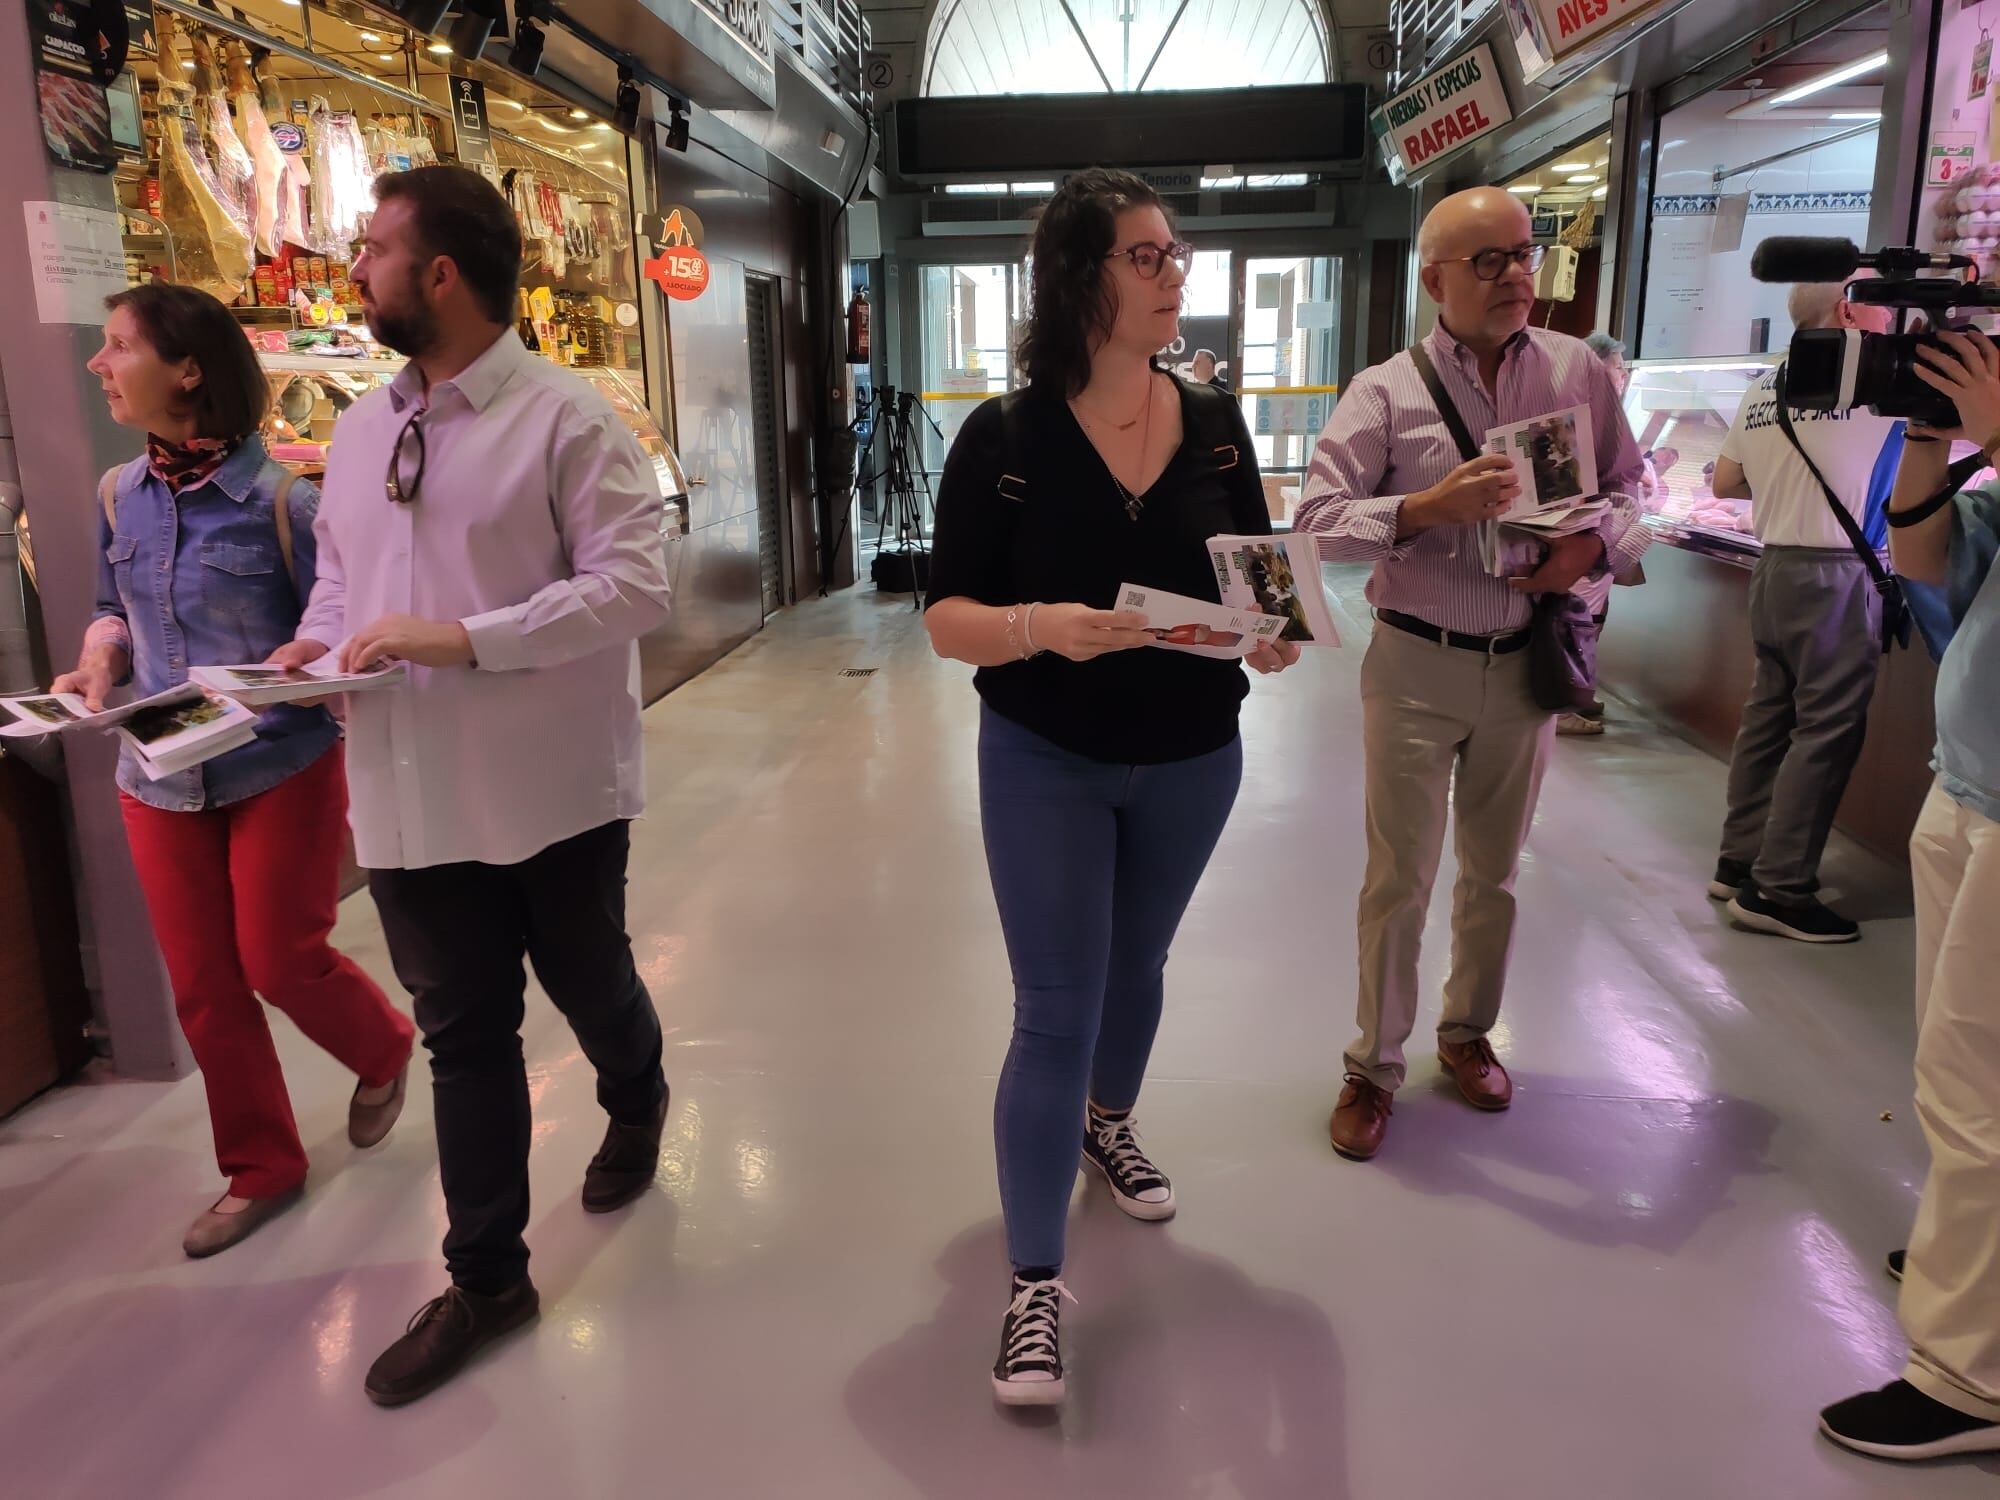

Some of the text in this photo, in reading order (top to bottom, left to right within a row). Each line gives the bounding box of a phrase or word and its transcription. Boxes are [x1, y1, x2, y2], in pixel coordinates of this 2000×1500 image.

[1387, 55, 1482, 130] HIERBAS Y ESPECIAS
[1404, 99, 1490, 165] RAFAEL
